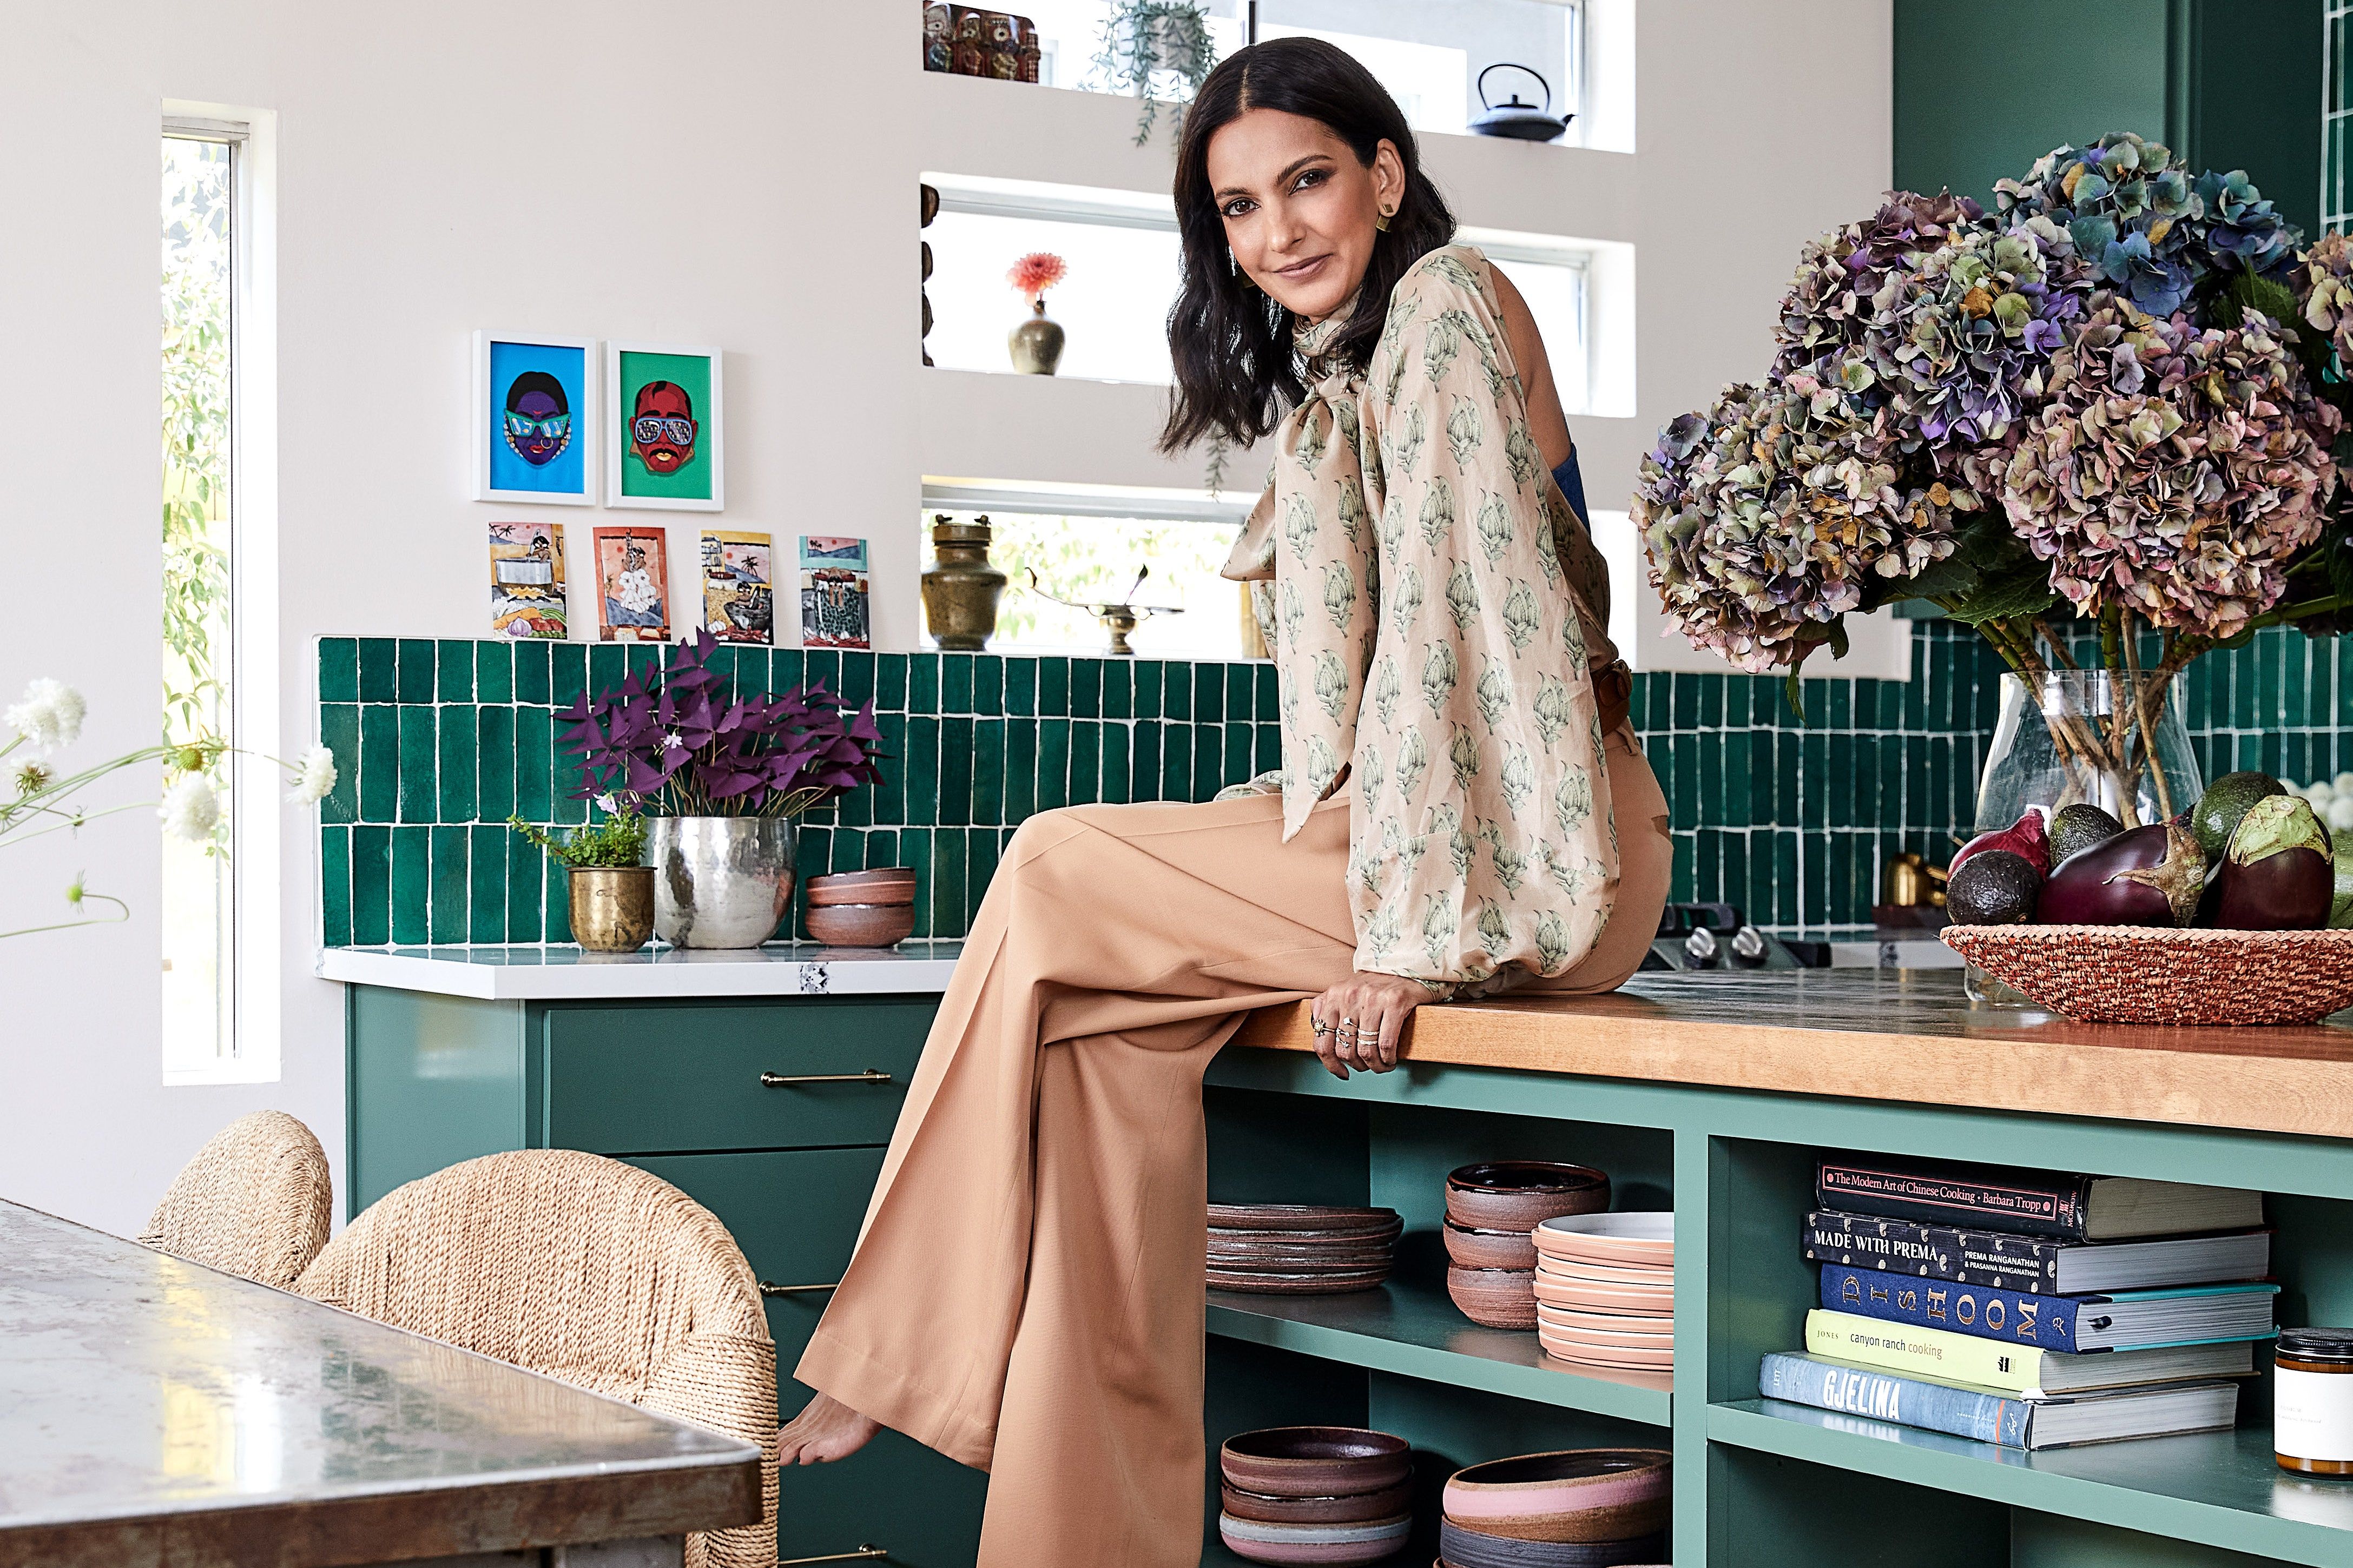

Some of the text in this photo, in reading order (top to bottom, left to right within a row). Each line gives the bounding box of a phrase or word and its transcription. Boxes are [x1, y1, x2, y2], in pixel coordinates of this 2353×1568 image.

[1835, 1173, 2041, 1213] The Modern Art of Chinese Cooking Barbara Tropp
[2068, 1190, 2077, 1227] MORROW
[1815, 1230, 1938, 1261] MADE WITH PREMA
[1965, 1251, 2040, 1268] PREMA RANGANATHAN
[1969, 1261, 1998, 1272] PRASANNA
[1999, 1265, 2040, 1278] RANGANATHAN
[1842, 1274, 2039, 1340] DISHOOM
[1817, 1330, 1839, 1340] JONES
[1850, 1333, 1942, 1360] canyon ranch cooking
[1823, 1369, 1901, 1420] GJELINA
